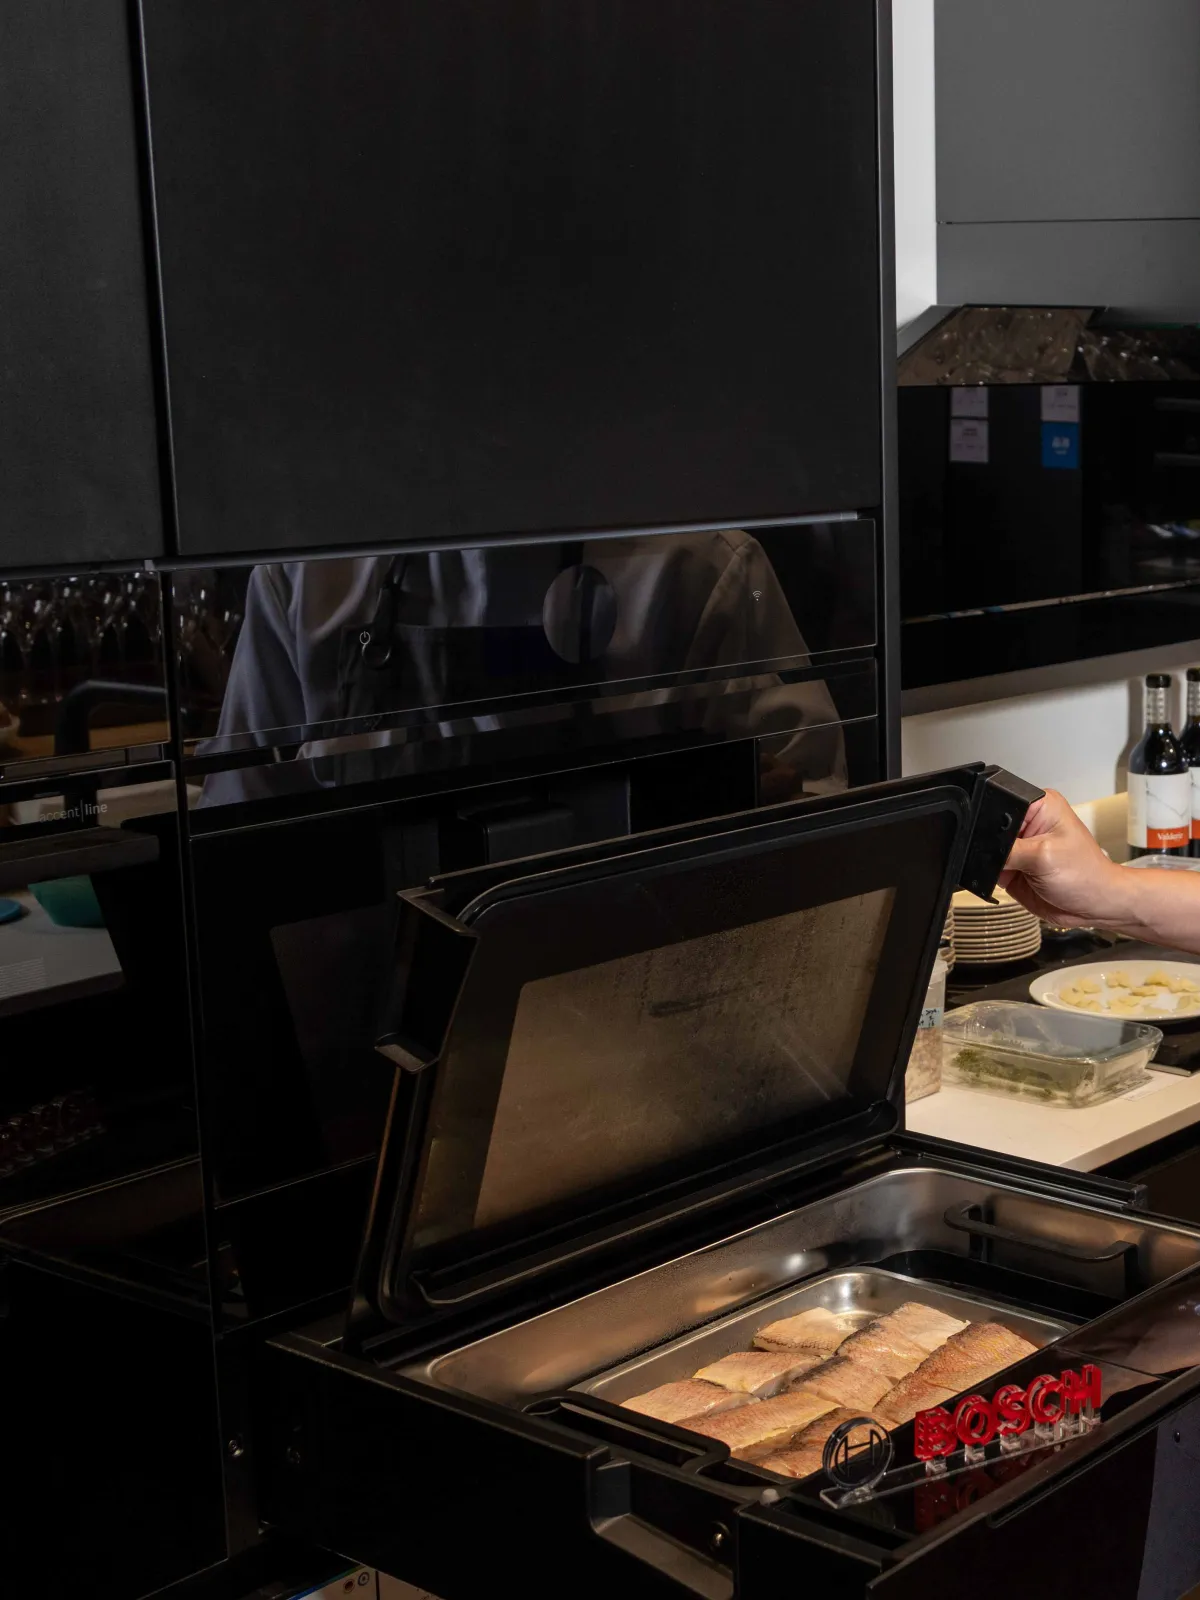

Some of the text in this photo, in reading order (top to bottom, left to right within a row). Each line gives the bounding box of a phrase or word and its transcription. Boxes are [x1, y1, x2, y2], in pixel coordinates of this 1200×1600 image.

[40, 803, 108, 823] accent line
[913, 1363, 1103, 1462] BOSCH
